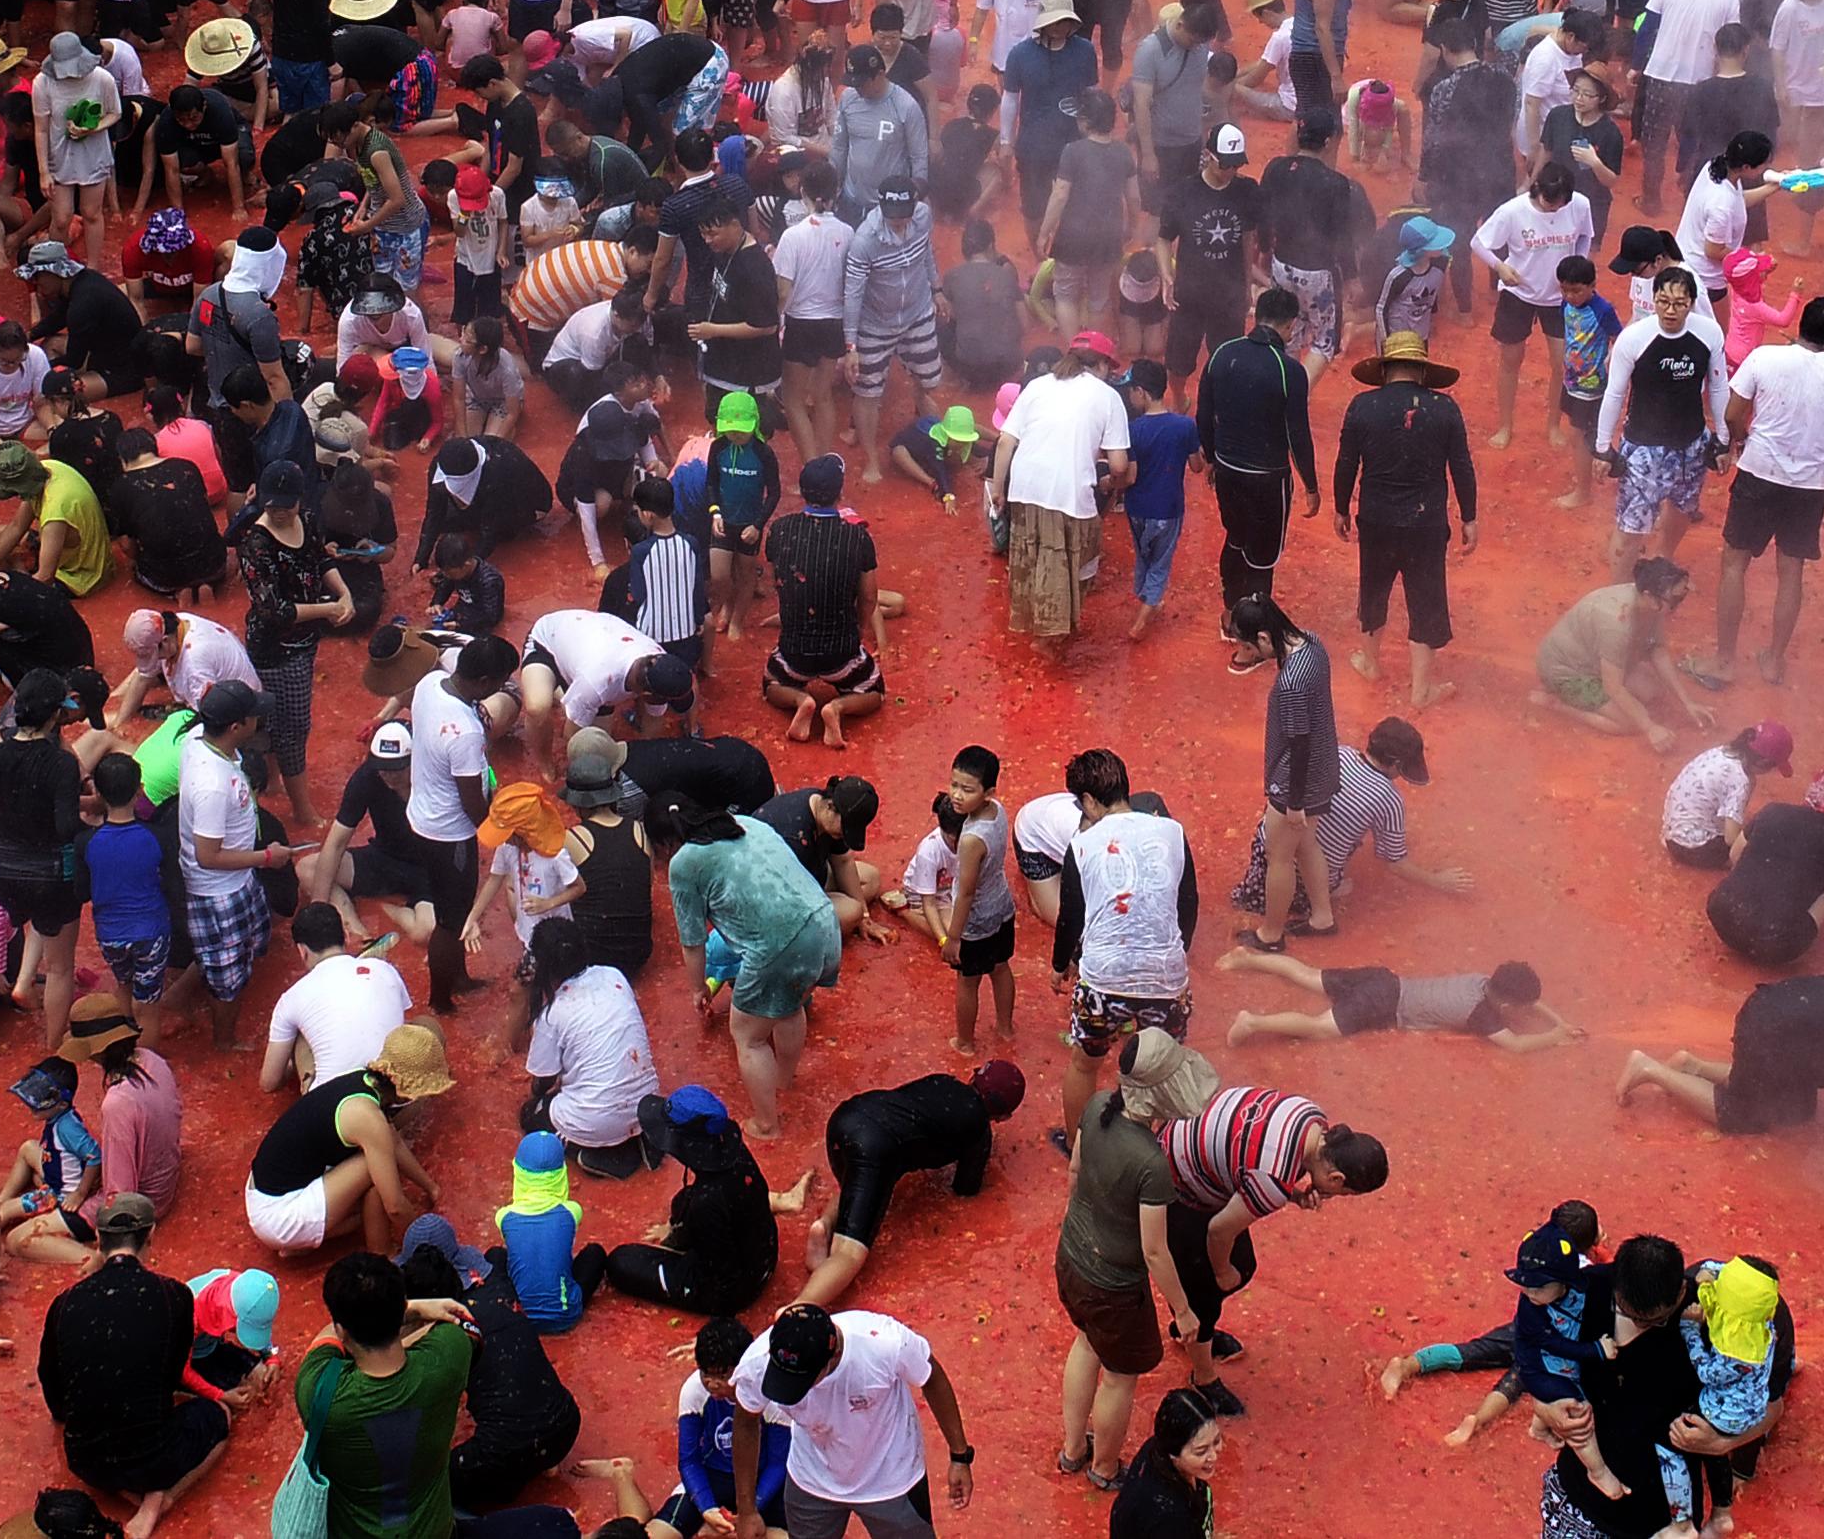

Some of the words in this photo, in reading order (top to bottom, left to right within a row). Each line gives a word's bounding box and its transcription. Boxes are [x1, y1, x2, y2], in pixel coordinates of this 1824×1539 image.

[878, 120, 894, 141] P
[1228, 139, 1241, 152] T
[885, 190, 910, 202] PING
[1202, 207, 1229, 222] west
